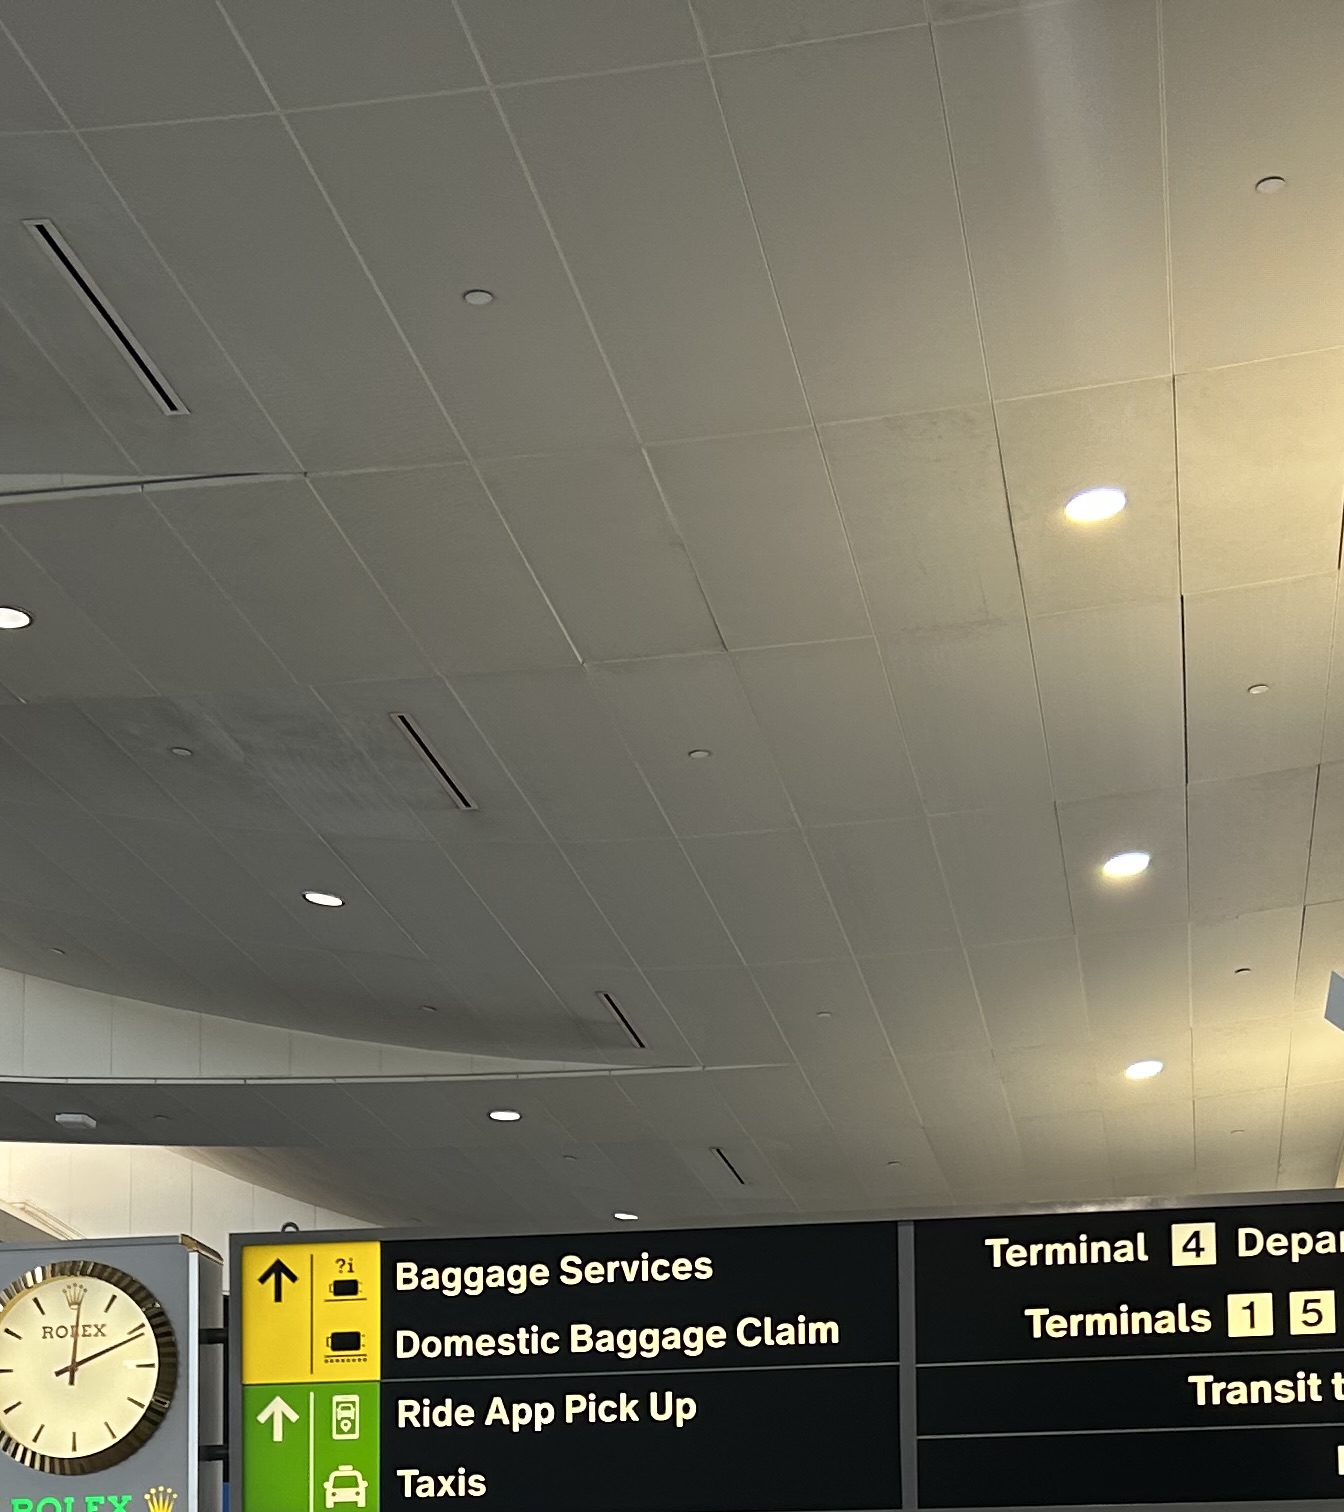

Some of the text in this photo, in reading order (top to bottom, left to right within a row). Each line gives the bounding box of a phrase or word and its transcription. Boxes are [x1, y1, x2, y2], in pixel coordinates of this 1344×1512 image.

[984, 1233, 1149, 1268] Terminal
[1182, 1230, 1205, 1258] 4
[396, 1252, 714, 1297] Baggage Services
[396, 1314, 839, 1359] Domestic Baggage Claim
[1024, 1303, 1212, 1338] Terminals
[1301, 1298, 1323, 1327] 5
[1187, 1371, 1323, 1406] Transit
[397, 1390, 697, 1433] Ride App Pick Up
[396, 1466, 487, 1498] Taxis
